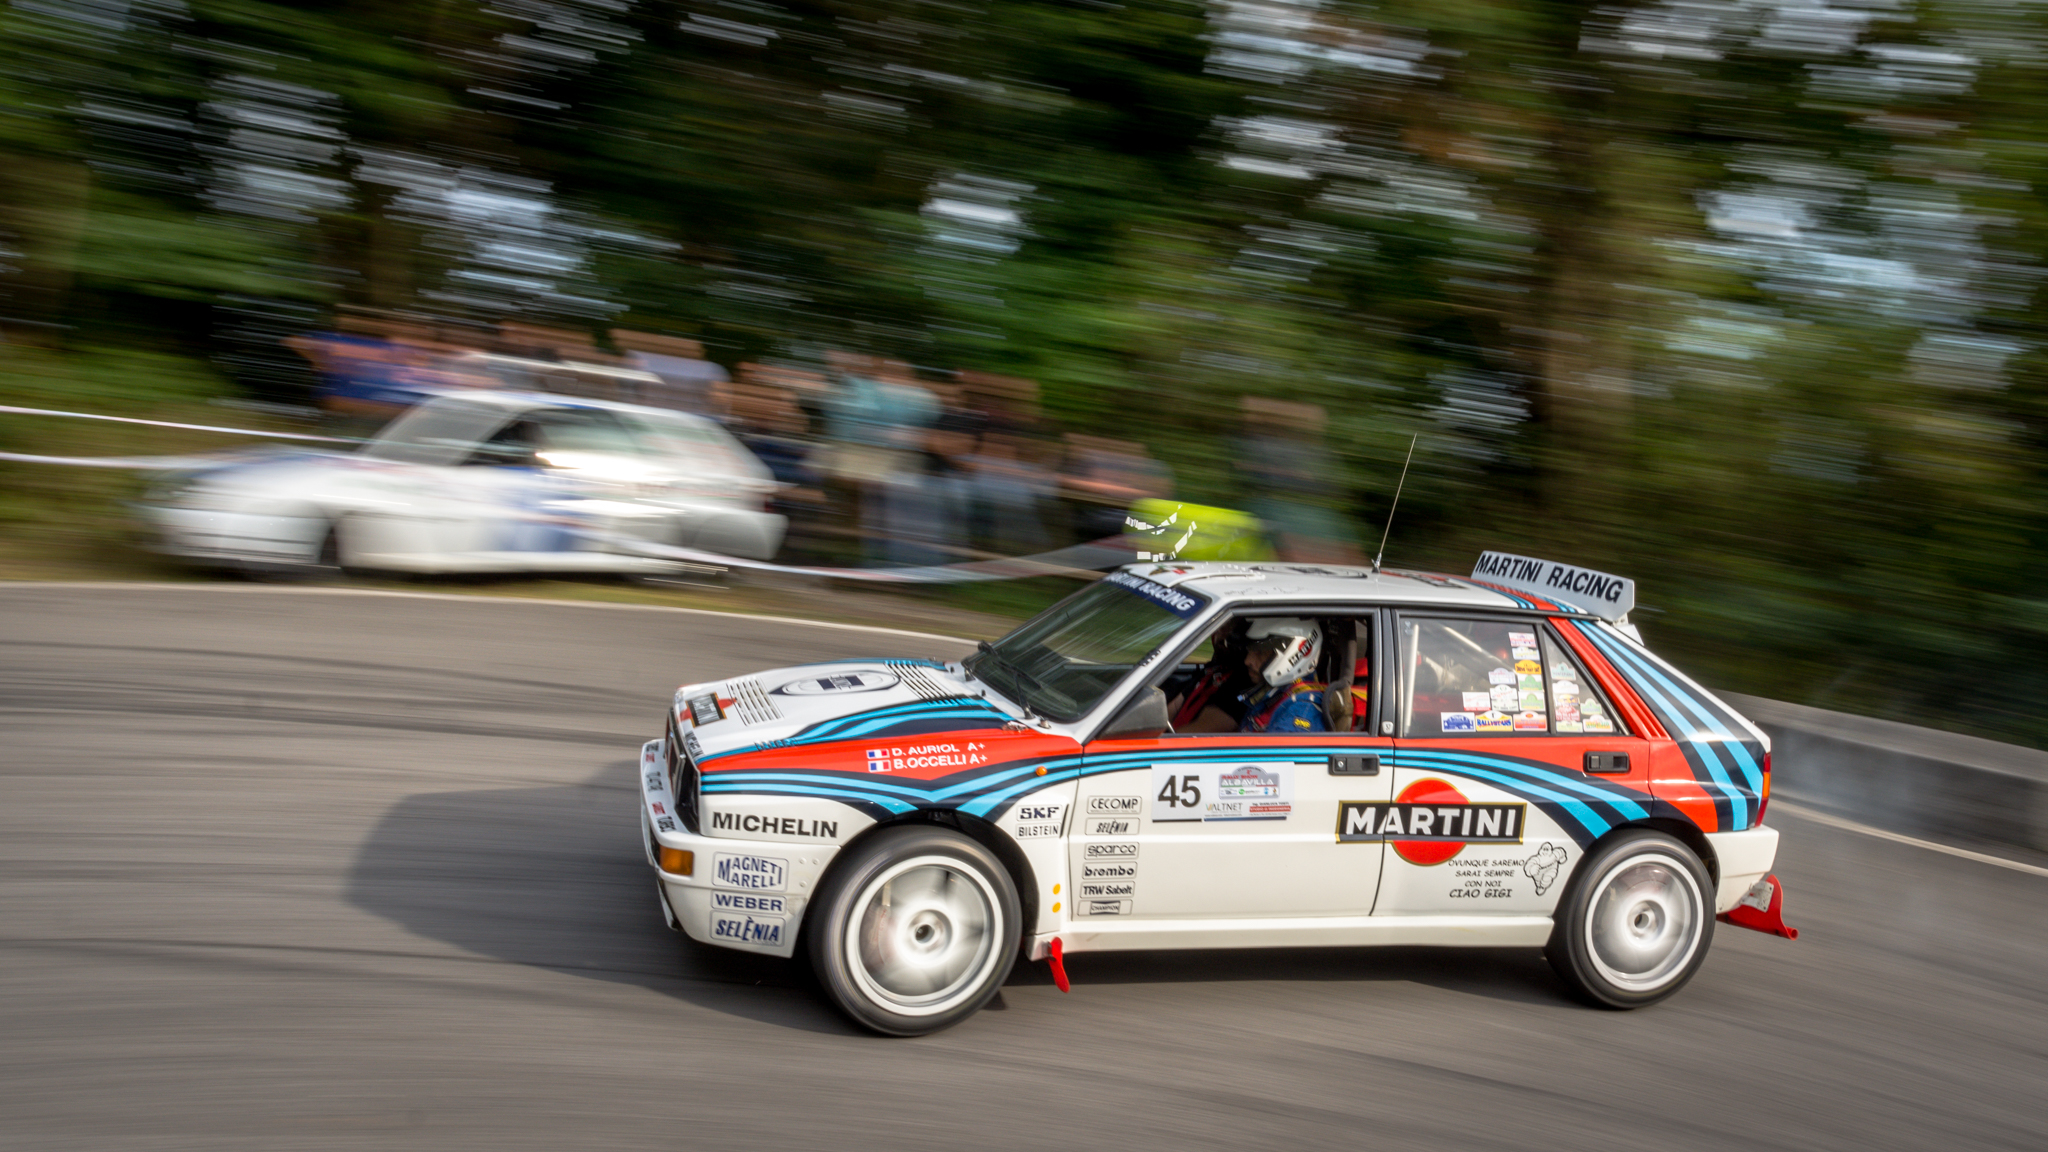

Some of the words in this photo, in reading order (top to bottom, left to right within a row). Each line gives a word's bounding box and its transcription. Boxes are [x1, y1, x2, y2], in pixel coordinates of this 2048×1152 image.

[1475, 554, 1544, 583] MARTINI
[1546, 565, 1624, 604] RACING
[1138, 582, 1196, 611] RACING
[892, 747, 906, 757] D.
[908, 743, 960, 756] AURIOL
[893, 755, 967, 770] B.OCCELLI
[1158, 775, 1201, 808] 45
[1091, 798, 1139, 810] CECOMP
[1020, 806, 1060, 819] SKF
[712, 811, 838, 838] MICHELIN
[1345, 806, 1517, 837] MARTINI
[1018, 825, 1059, 837] BILSTEIN
[1087, 844, 1137, 857] sparco
[718, 856, 782, 880] MAGNETI
[1448, 859, 1489, 867] OVUNQUE
[1491, 859, 1525, 867] SAREMO
[1084, 865, 1134, 877] brembo
[1083, 886, 1104, 895] TRW
[1105, 885, 1133, 896] Sabelt
[1449, 889, 1481, 898] CIAO
[1484, 889, 1512, 898] GIGI
[715, 893, 783, 912] WEBER
[715, 916, 781, 941] SELÈNIA
